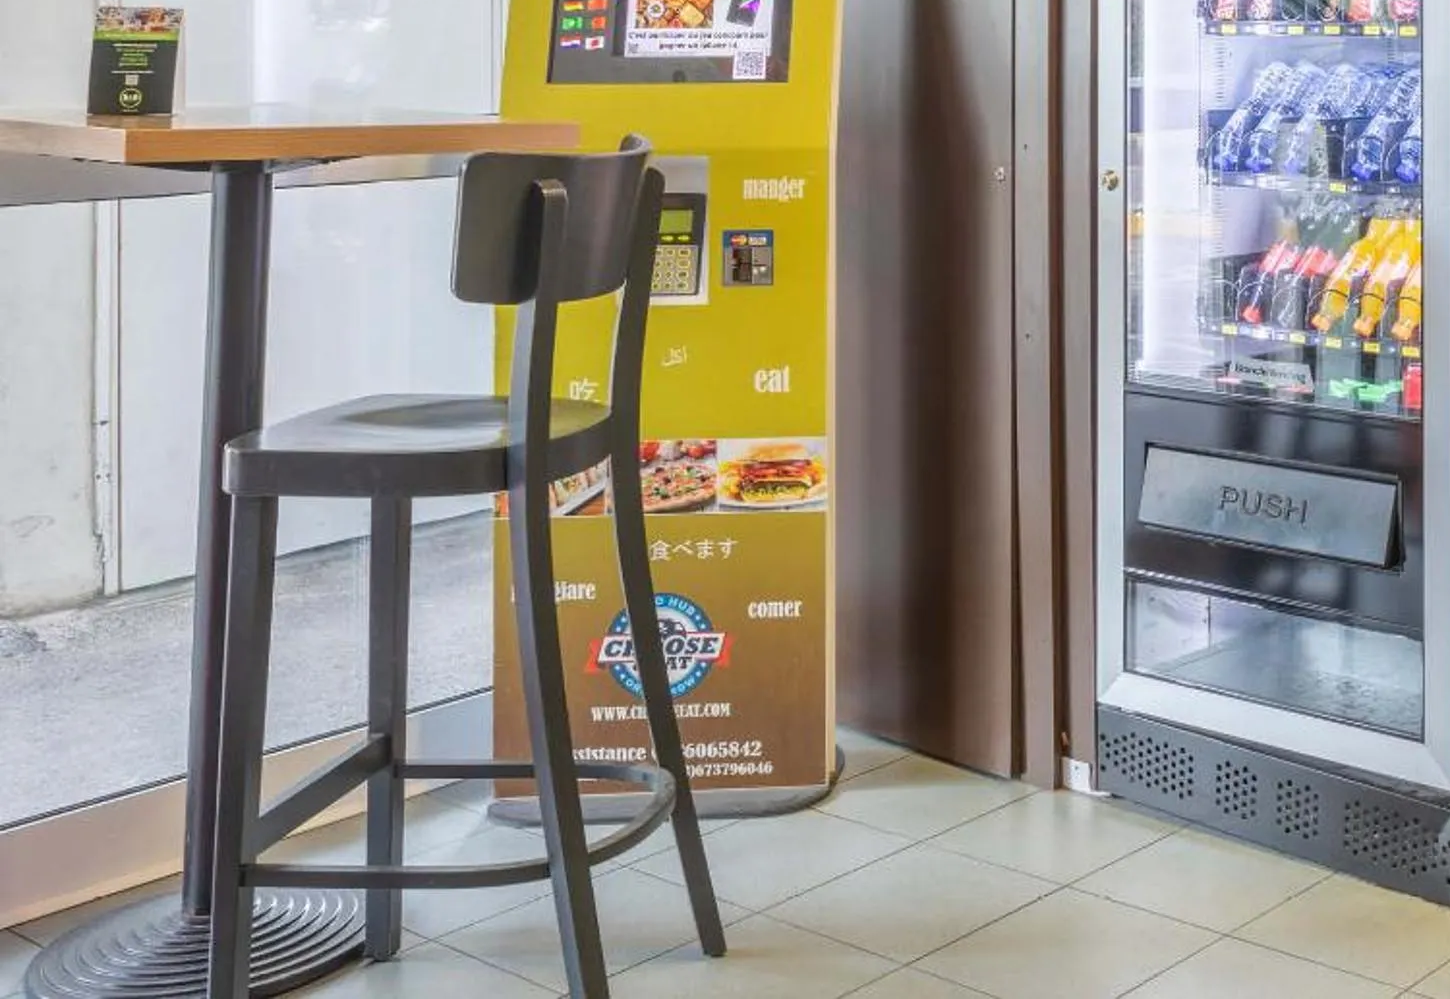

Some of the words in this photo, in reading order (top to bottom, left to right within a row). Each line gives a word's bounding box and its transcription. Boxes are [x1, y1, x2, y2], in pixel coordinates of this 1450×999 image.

[743, 176, 807, 202] manger
[754, 366, 790, 393] eat
[1218, 485, 1309, 524] PUSH
[748, 600, 803, 619] comer
